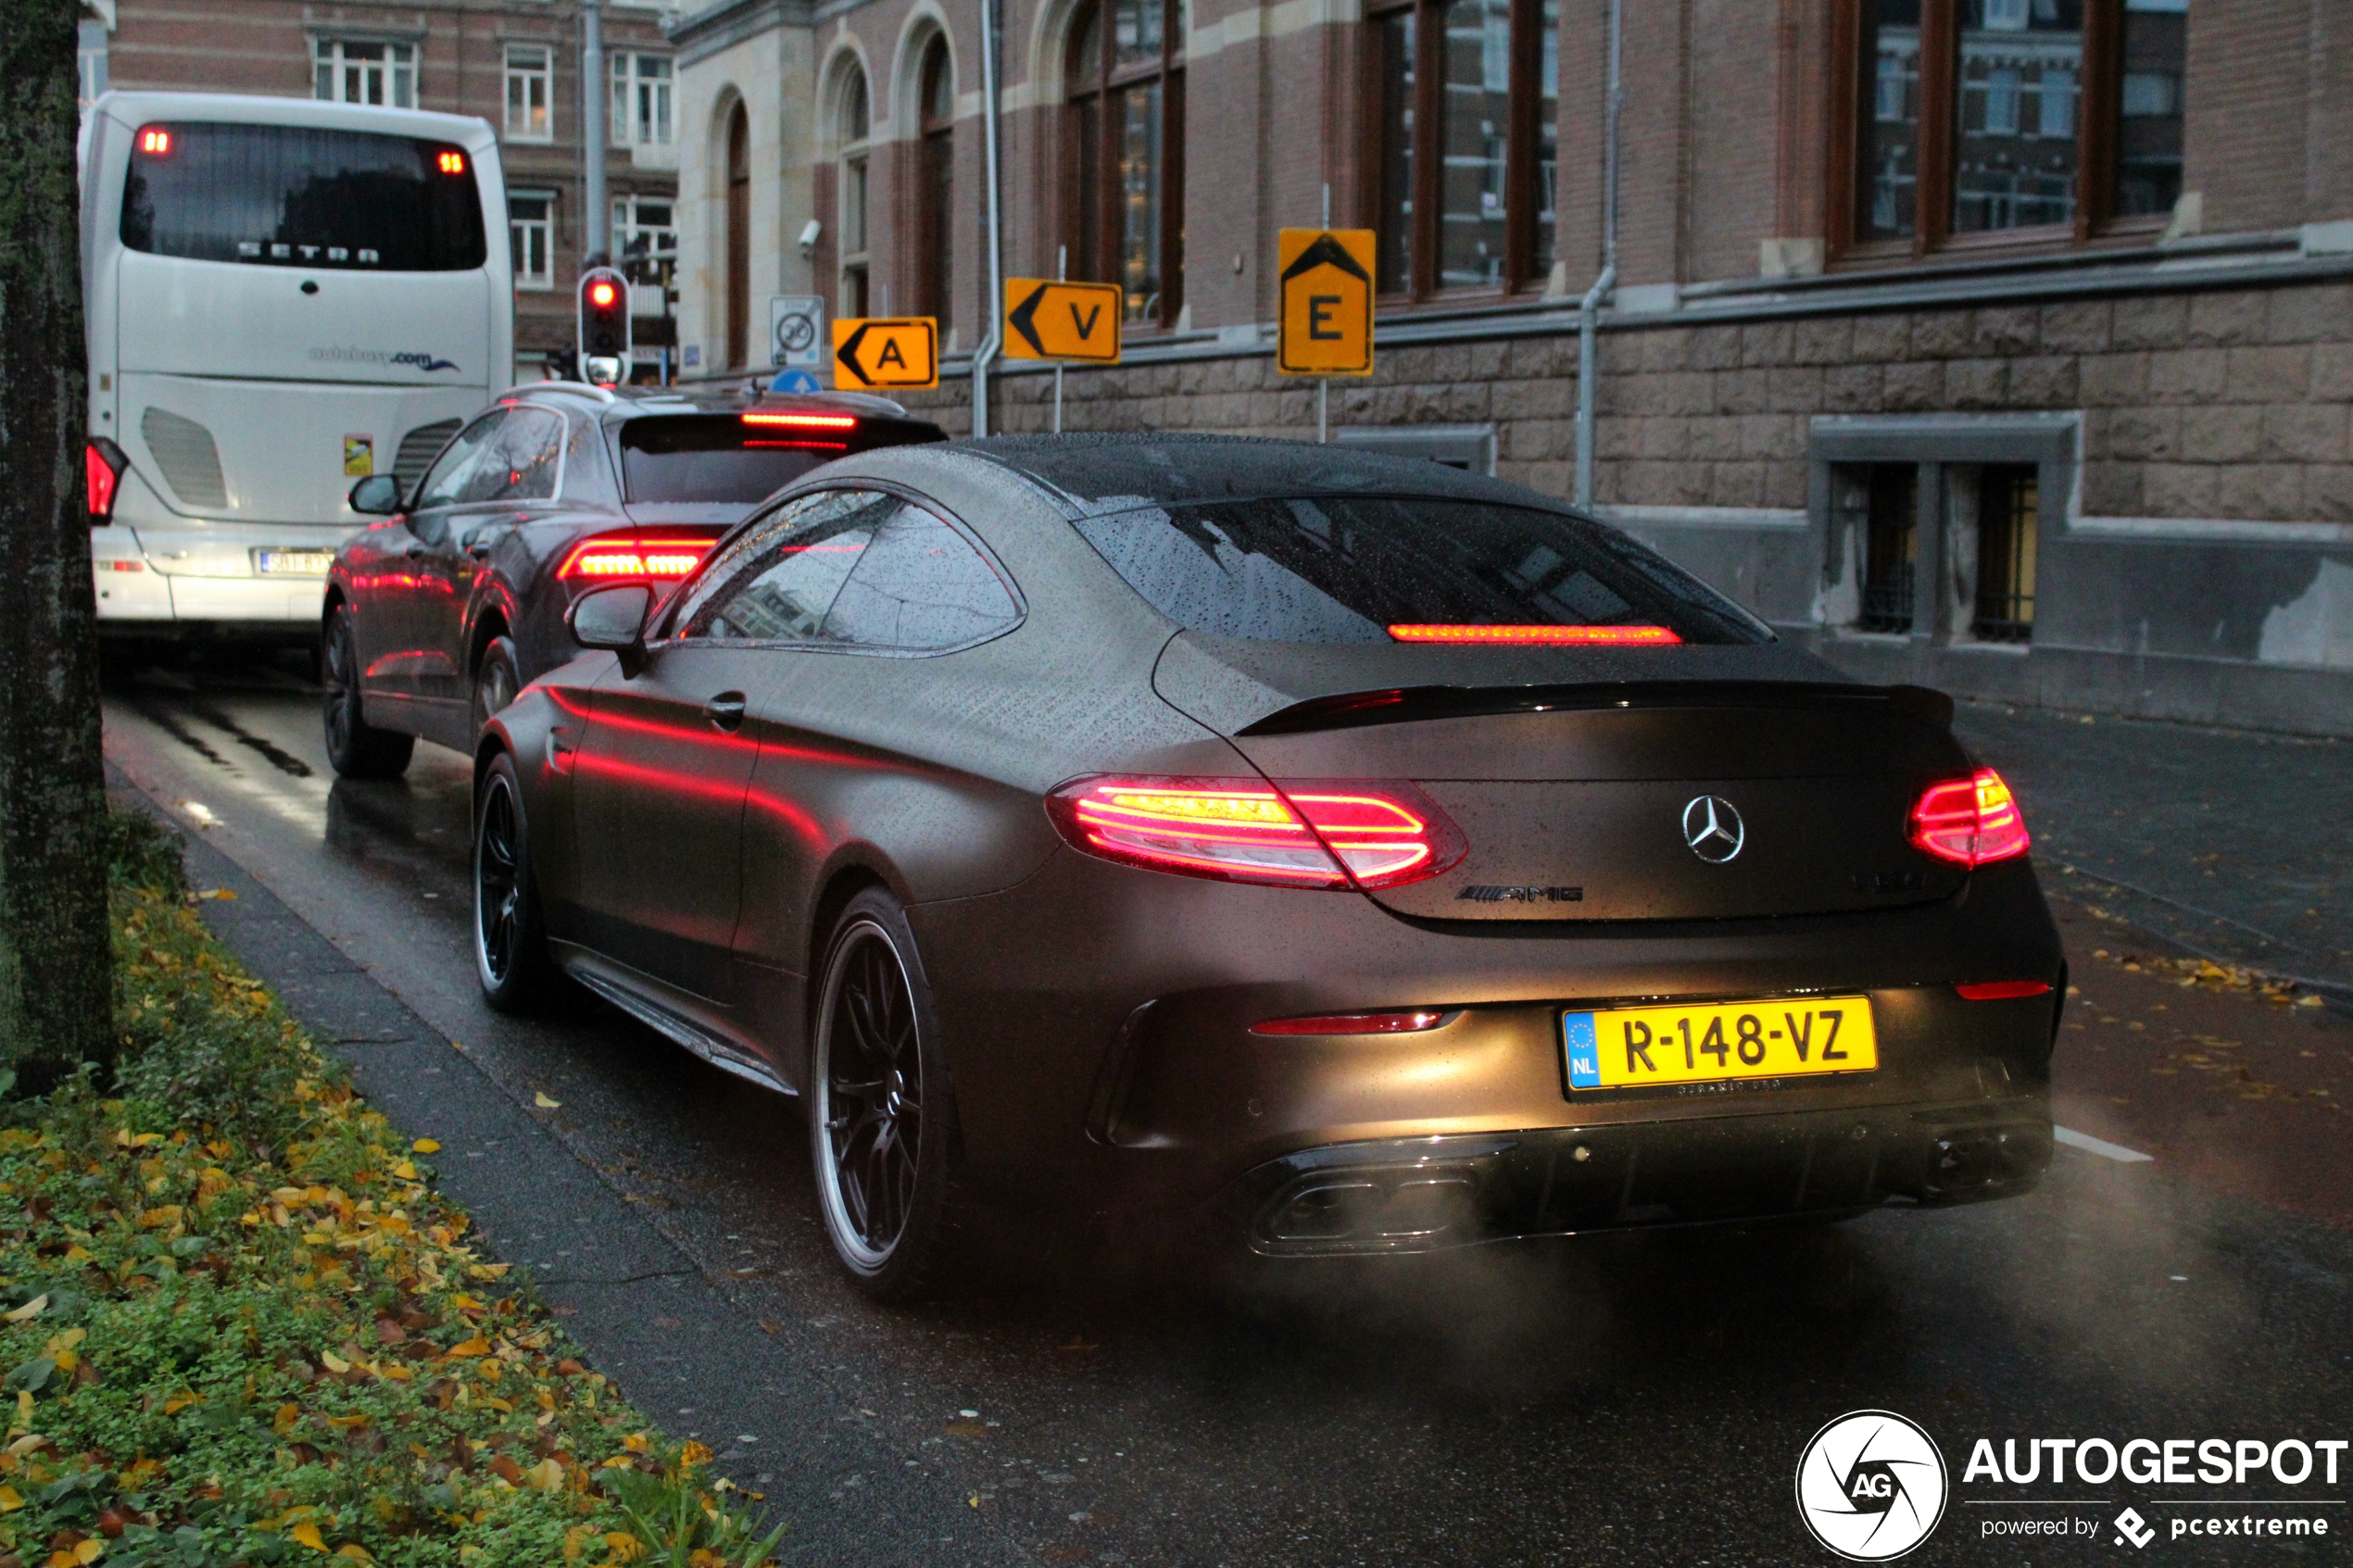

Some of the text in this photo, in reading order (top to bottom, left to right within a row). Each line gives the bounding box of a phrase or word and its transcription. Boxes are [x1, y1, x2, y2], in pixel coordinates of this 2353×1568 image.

[238, 242, 379, 263] SETRA
[1070, 303, 1101, 340] V
[1310, 295, 1342, 340] E
[876, 337, 907, 370] A
[1491, 885, 1583, 902] AMG
[1623, 1010, 1849, 1073] R-148-VZ
[1574, 1058, 1595, 1075] NL
